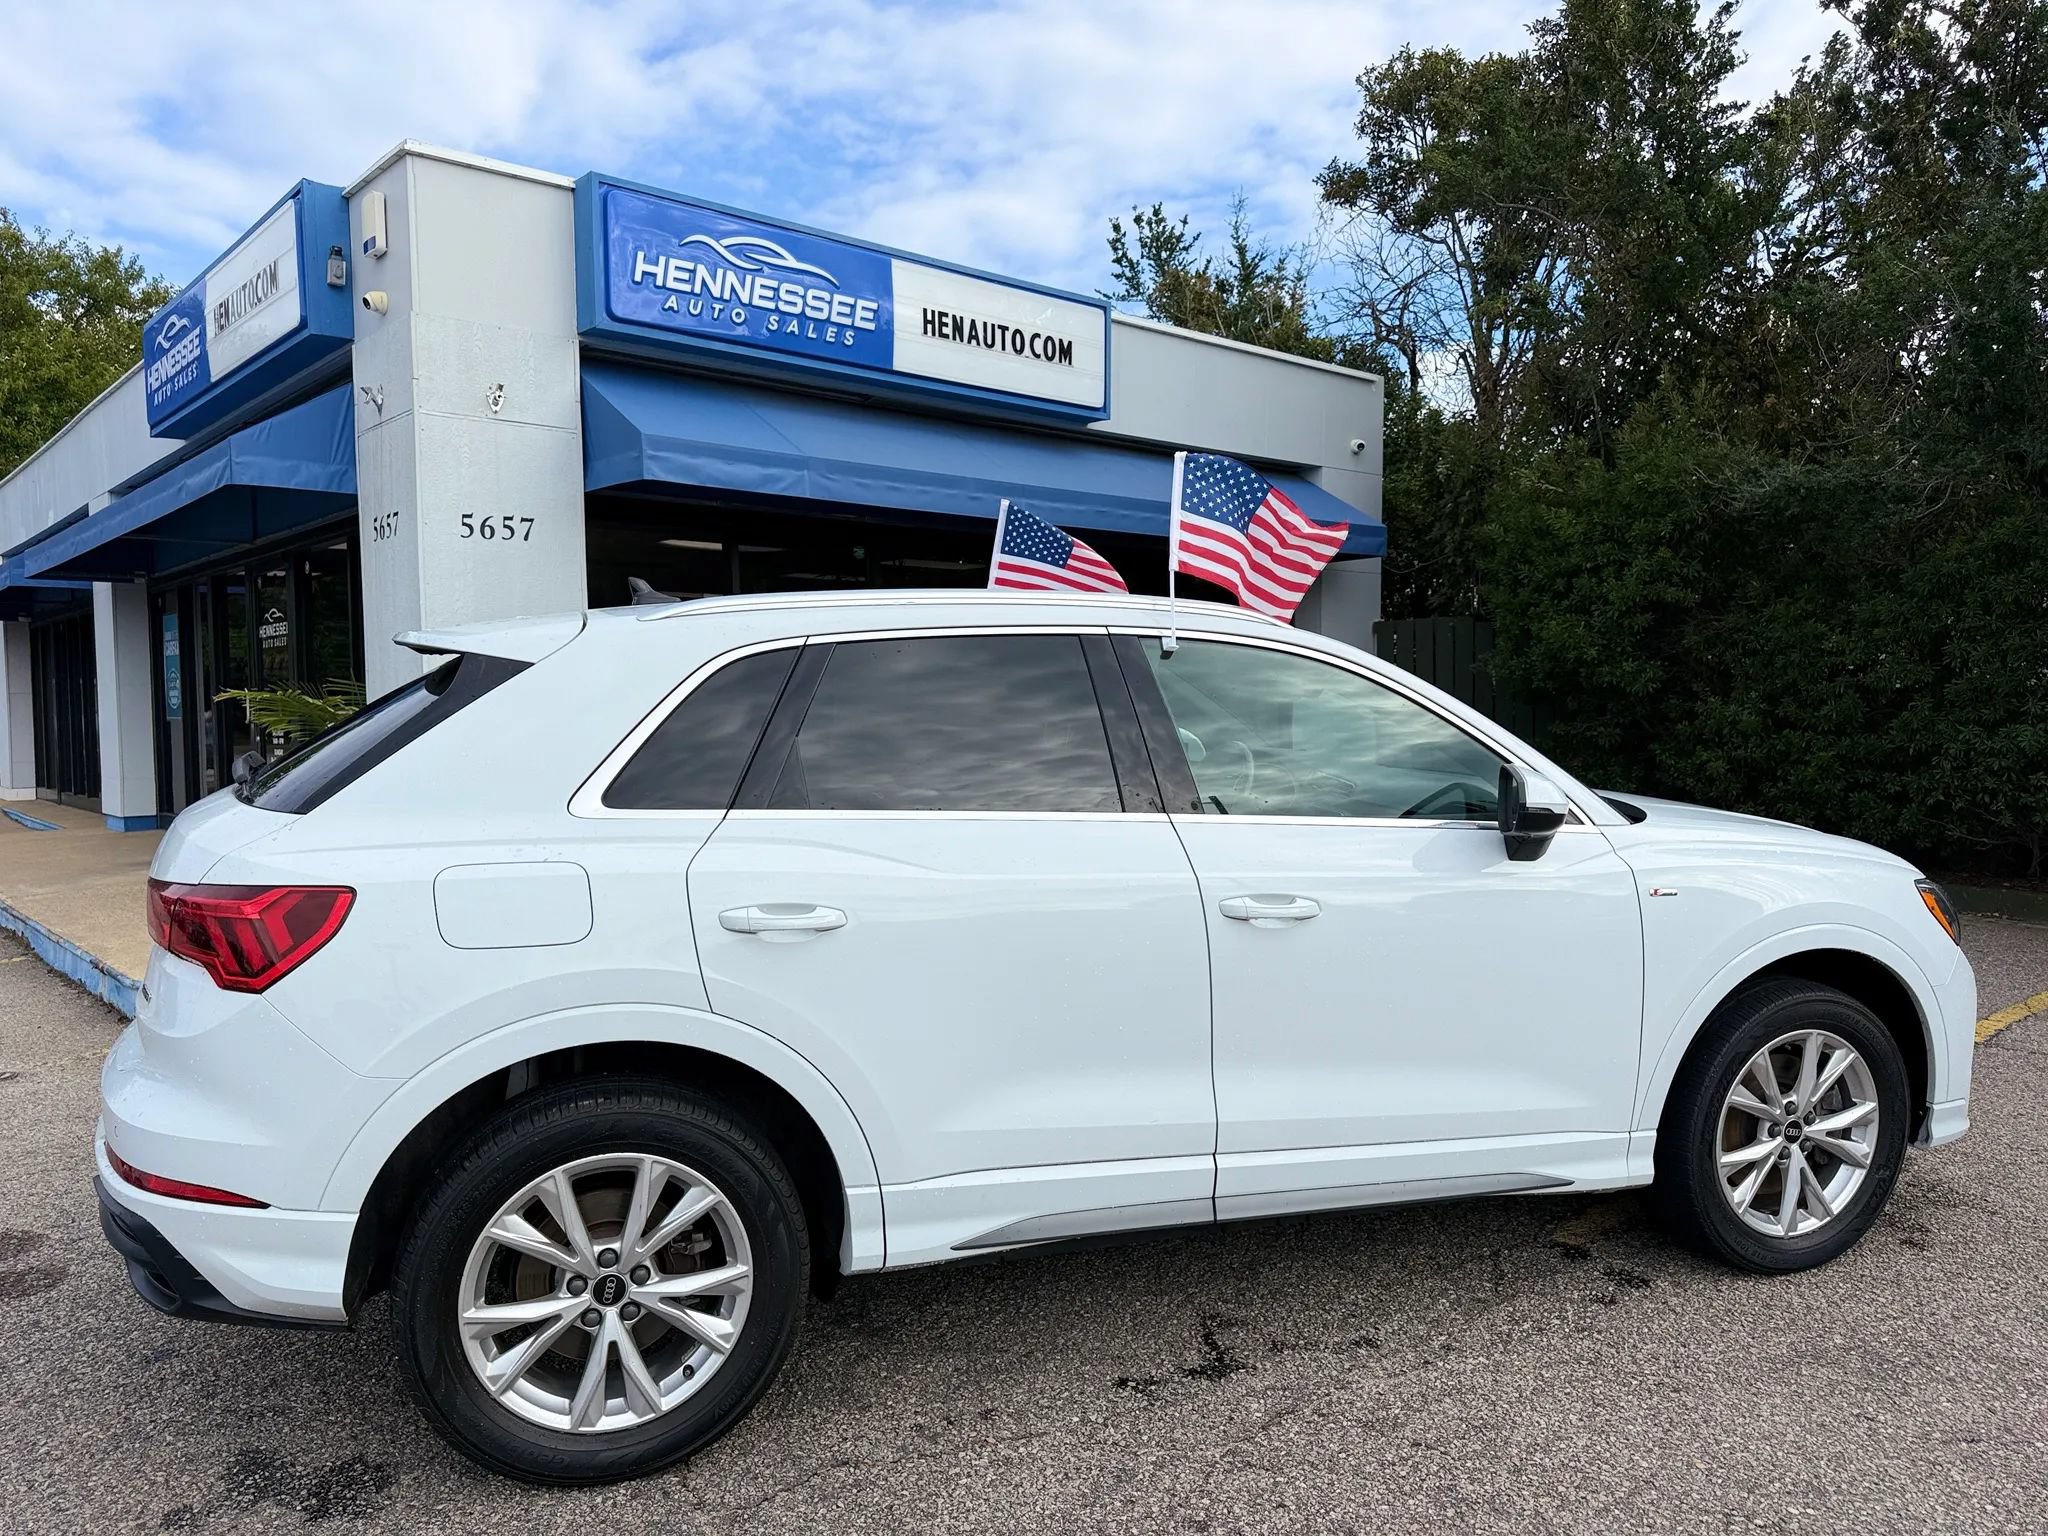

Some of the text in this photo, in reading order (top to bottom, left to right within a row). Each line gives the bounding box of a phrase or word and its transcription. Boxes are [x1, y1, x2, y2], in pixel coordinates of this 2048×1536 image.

[634, 251, 878, 331] HENNESSEE
[663, 296, 855, 347] AUTO SALES
[147, 326, 201, 394] HENNESSEE
[153, 366, 199, 407] AUTO SALES
[373, 510, 399, 542] 5657
[460, 512, 535, 542] 5657
